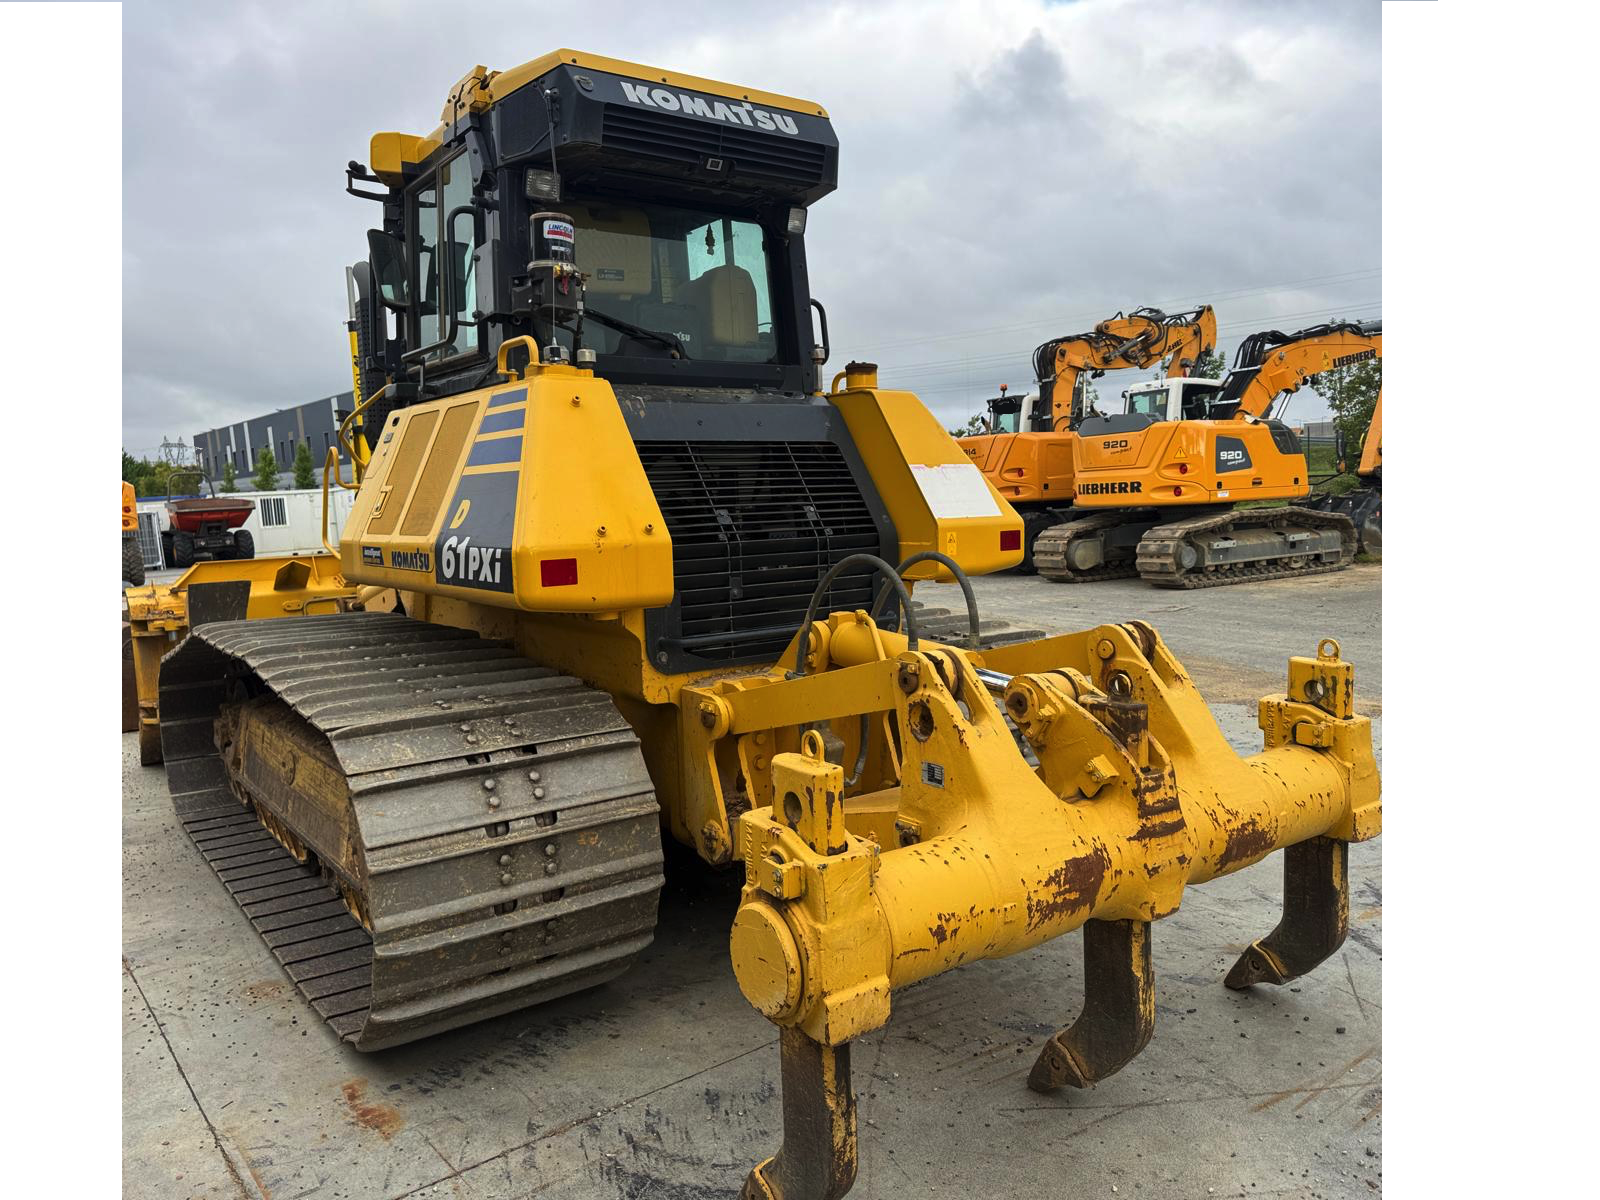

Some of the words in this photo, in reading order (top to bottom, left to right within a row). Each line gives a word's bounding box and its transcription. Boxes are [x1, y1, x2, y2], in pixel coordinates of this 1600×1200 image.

[620, 81, 799, 135] KOMATSU
[548, 223, 573, 233] LINCOLN
[1332, 348, 1376, 368] LIEBHERR
[1103, 440, 1128, 449] 920
[1220, 450, 1243, 460] 920
[1078, 481, 1142, 495] LIEBHERR
[450, 500, 471, 529] D
[391, 547, 430, 571] KOMATSU
